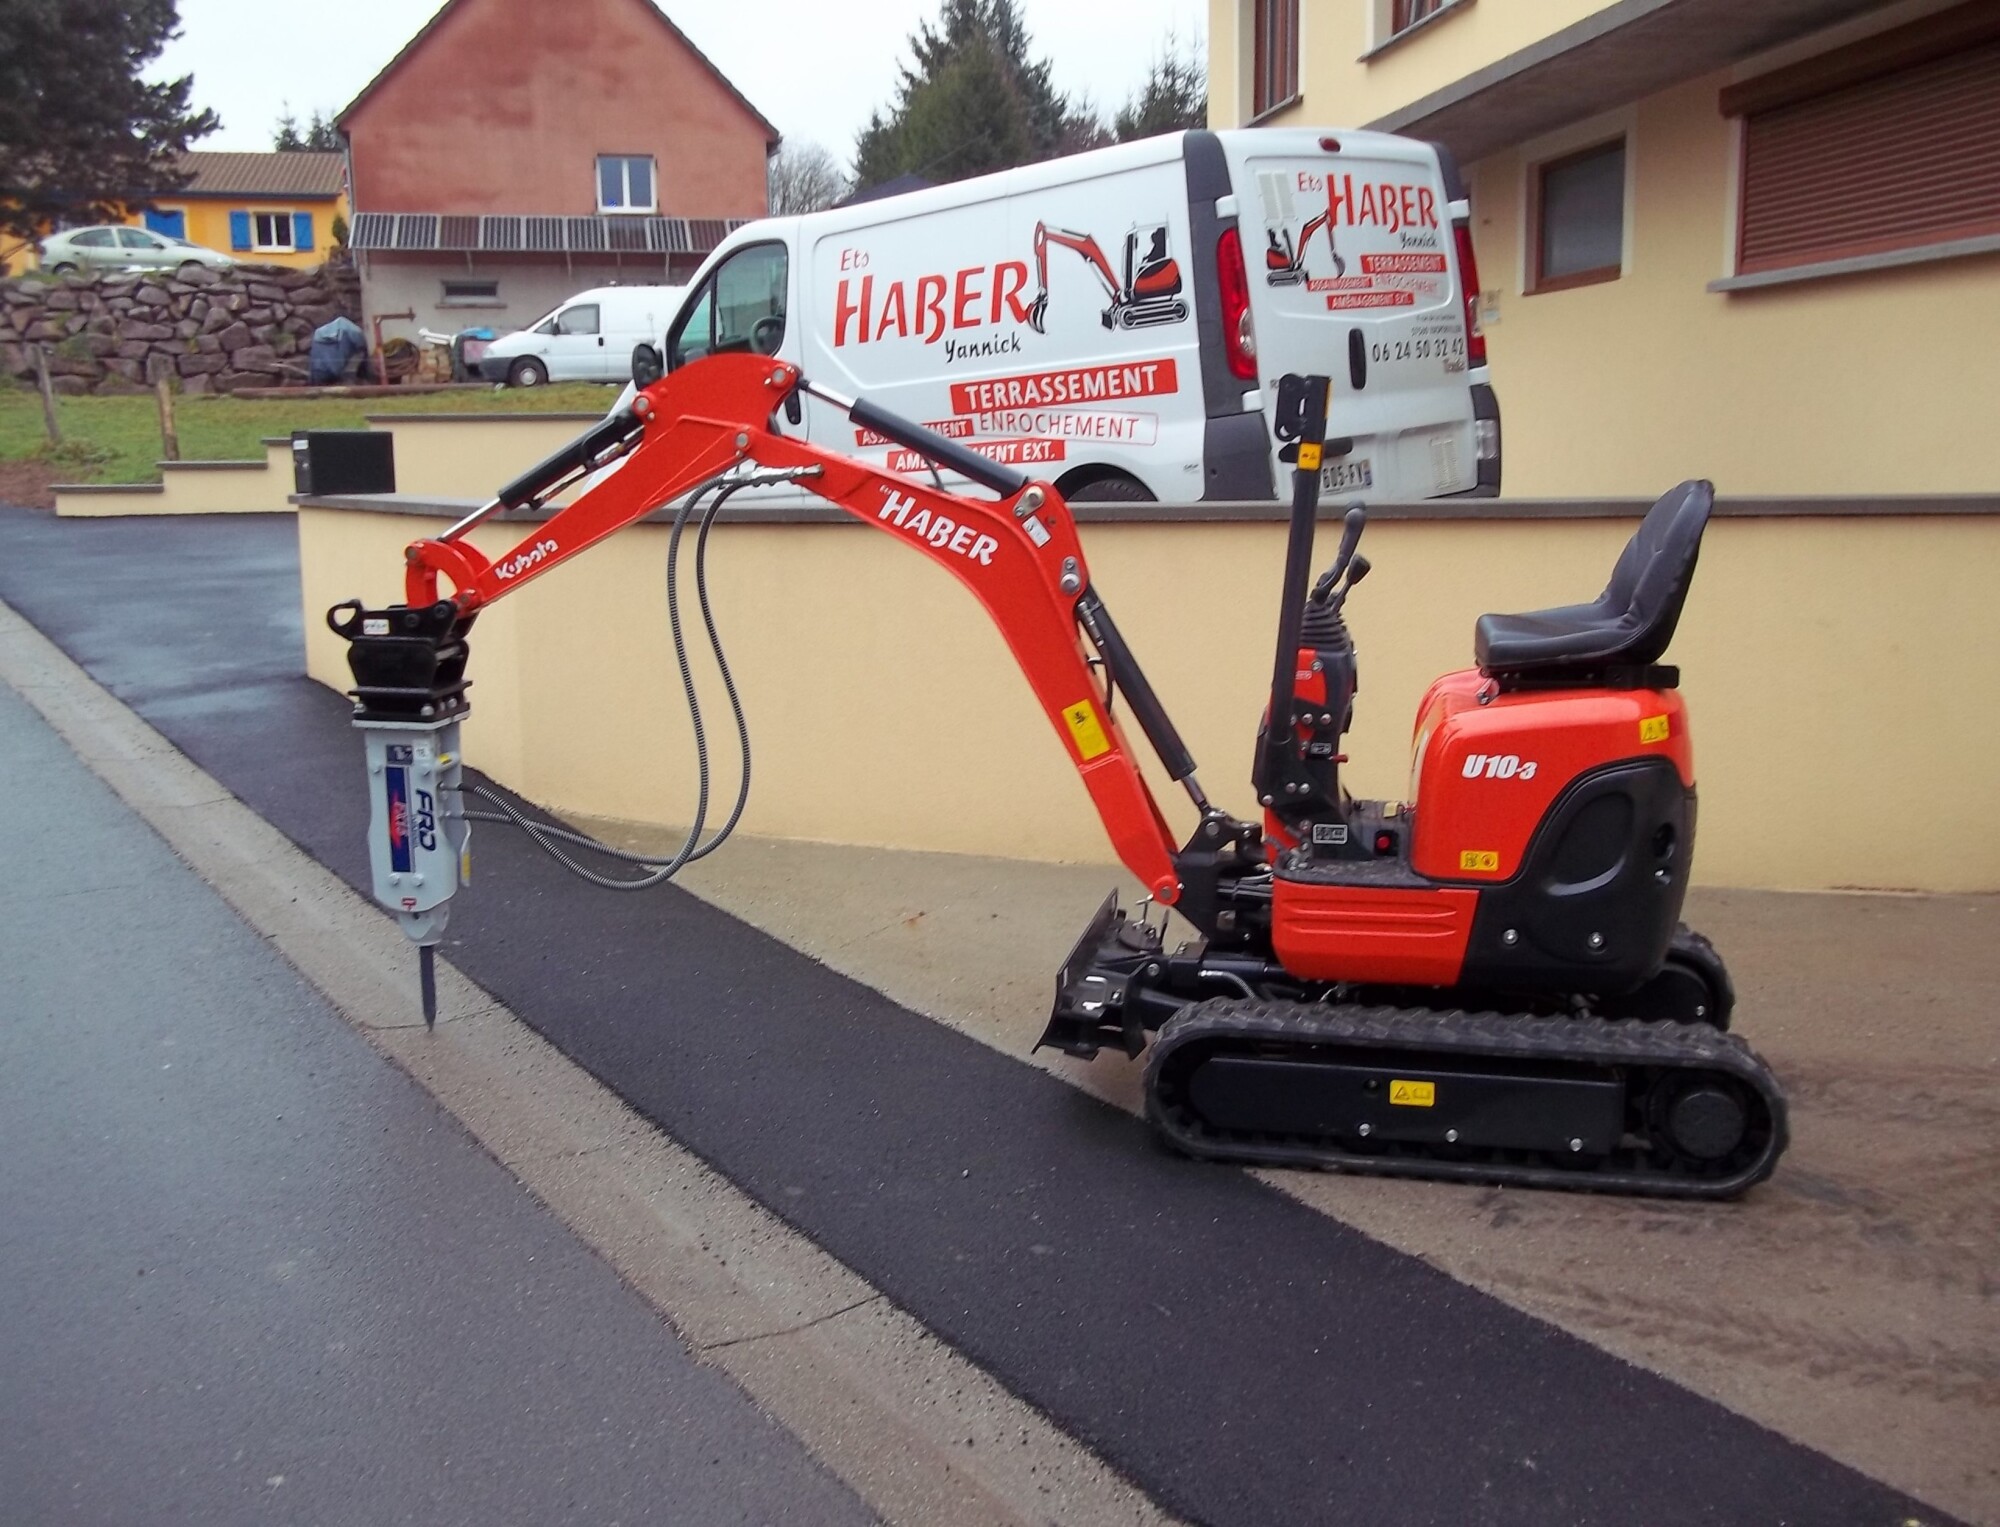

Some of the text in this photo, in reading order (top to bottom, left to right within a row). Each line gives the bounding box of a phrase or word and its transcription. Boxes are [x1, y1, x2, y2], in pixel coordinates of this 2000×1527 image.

[1298, 172, 1438, 233] Ets HABER
[840, 248, 870, 271] Ets
[1367, 255, 1441, 272] TERRASSEMENT
[834, 260, 1032, 348] HABER
[944, 331, 1022, 363] Yannick
[1372, 338, 1464, 362] 06 24 50 32 42
[964, 365, 1158, 410] TERRASSEMENT
[980, 411, 1139, 439] ENROCHEMENT
[1022, 441, 1056, 461] EXT.
[878, 490, 999, 566] HABER
[495, 539, 558, 580] Kubota
[1461, 754, 1538, 780] U10-3
[416, 788, 436, 852] FRD
